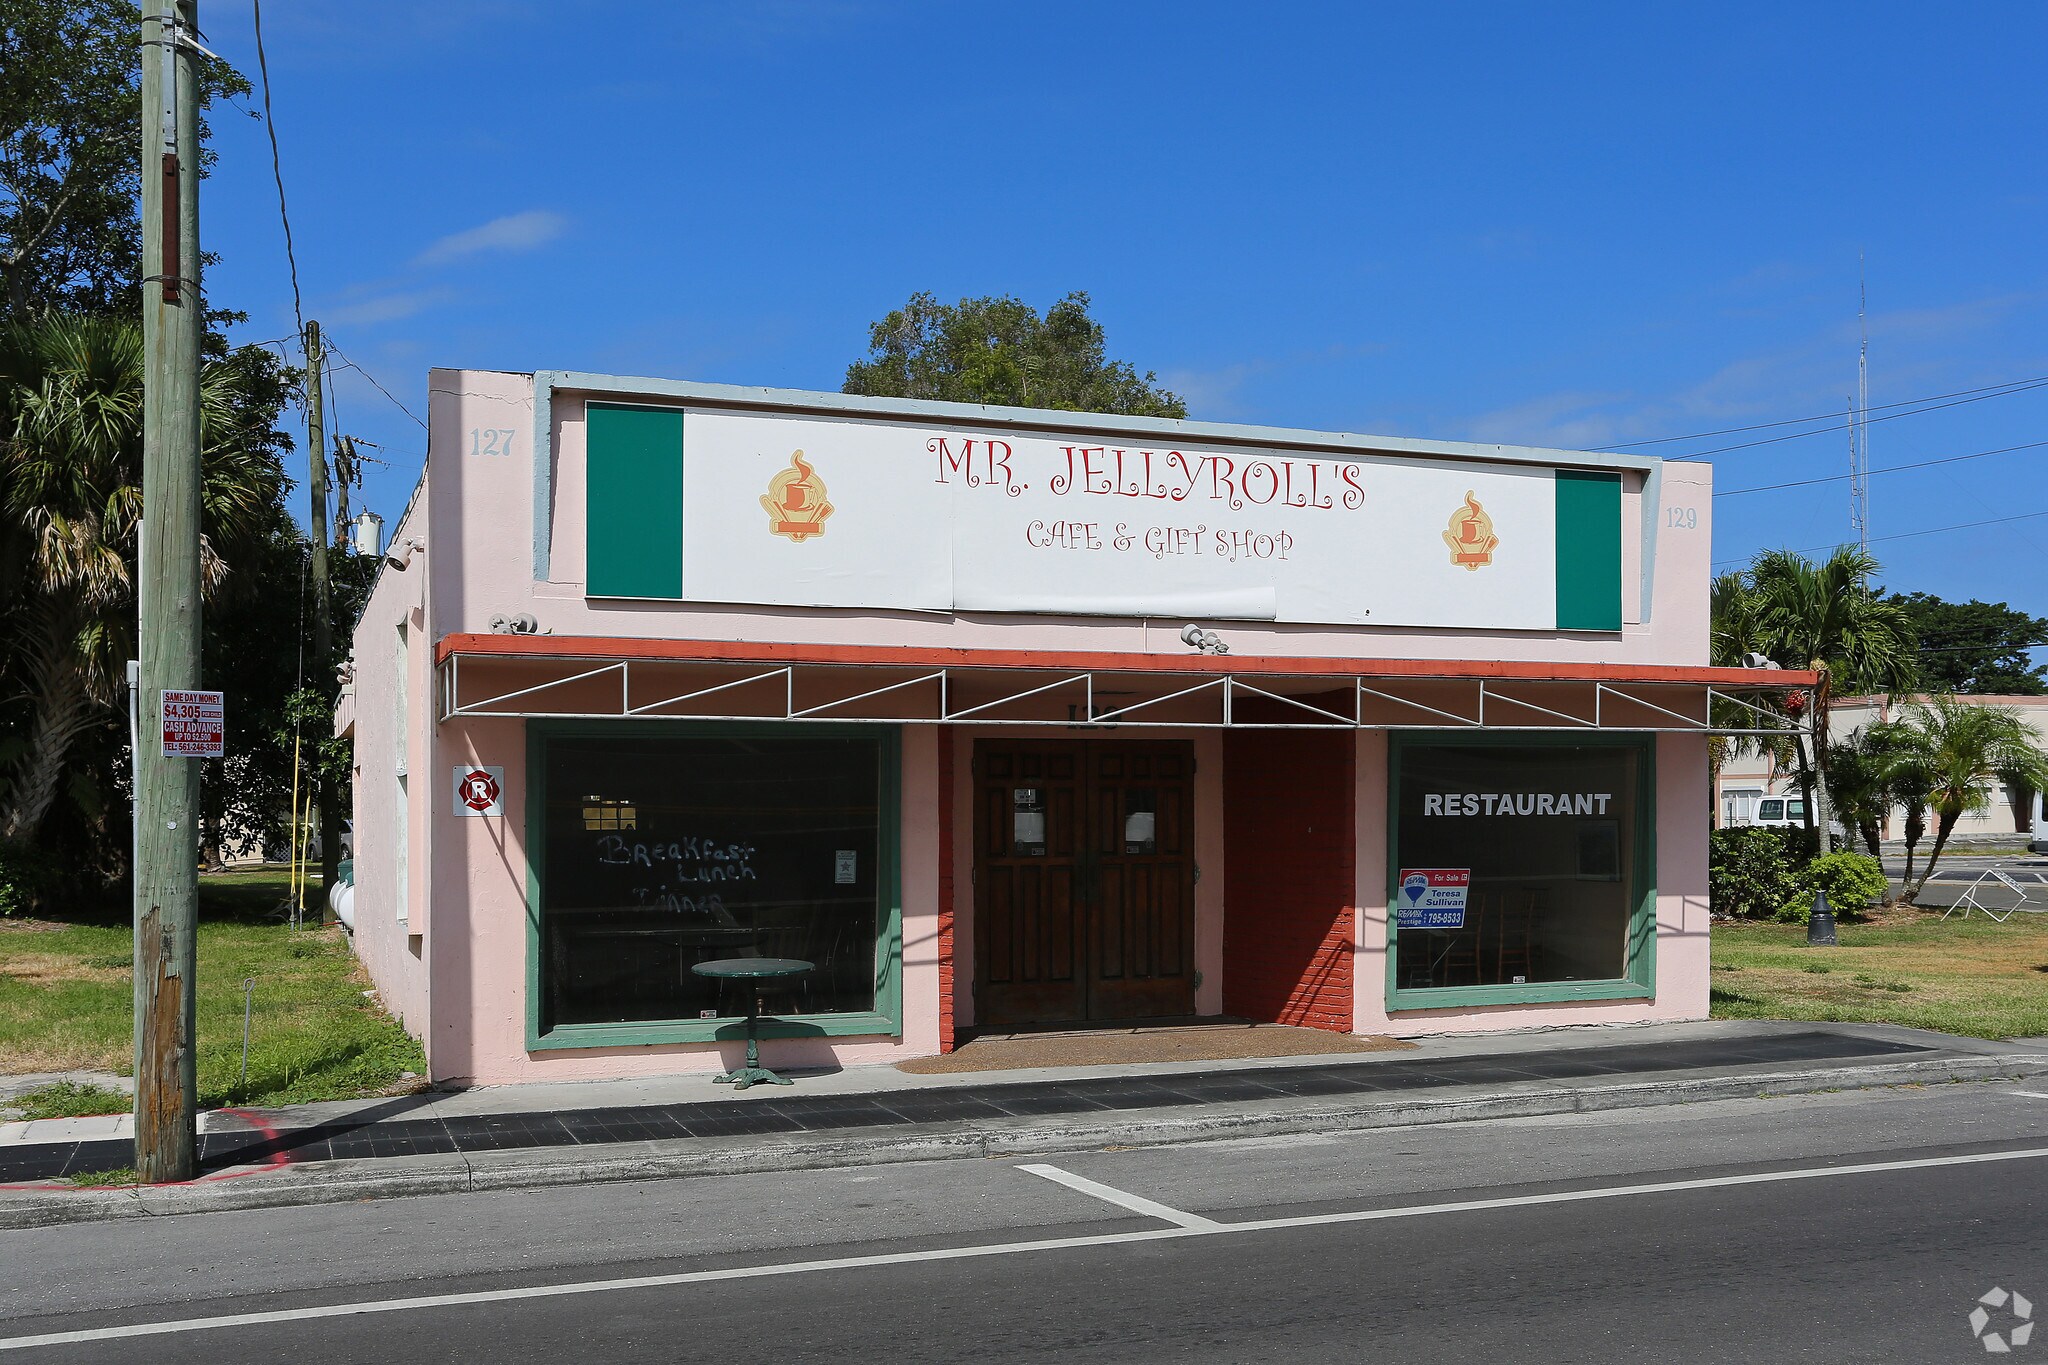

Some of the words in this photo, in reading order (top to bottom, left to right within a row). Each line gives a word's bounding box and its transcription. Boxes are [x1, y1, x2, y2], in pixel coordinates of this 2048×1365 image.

[470, 428, 516, 457] 127
[926, 437, 1029, 497] MR.
[1049, 446, 1367, 511] JELLYROLL'S
[1665, 506, 1698, 530] 129
[1026, 519, 1102, 551] CAFE
[1113, 522, 1137, 552] &
[1144, 524, 1207, 560] GIFT
[1215, 529, 1294, 562] SHOP
[165, 692, 183, 701] SAME
[185, 693, 198, 702] DAY
[199, 694, 220, 703] MONEY
[164, 704, 200, 720] $4,305
[164, 721, 184, 733] CASH
[186, 722, 221, 734] ADVANCE
[174, 733, 183, 741] UP
[184, 733, 191, 741] TO
[164, 742, 177, 751] TEL:
[471, 781, 488, 799] R
[1424, 793, 1612, 816] RESTAURANT
[1434, 874, 1444, 882] For
[1446, 874, 1459, 882] Sale
[1431, 889, 1460, 897] Teresa
[1426, 898, 1464, 906] Sullivan
[1428, 913, 1461, 924] 795-8533
